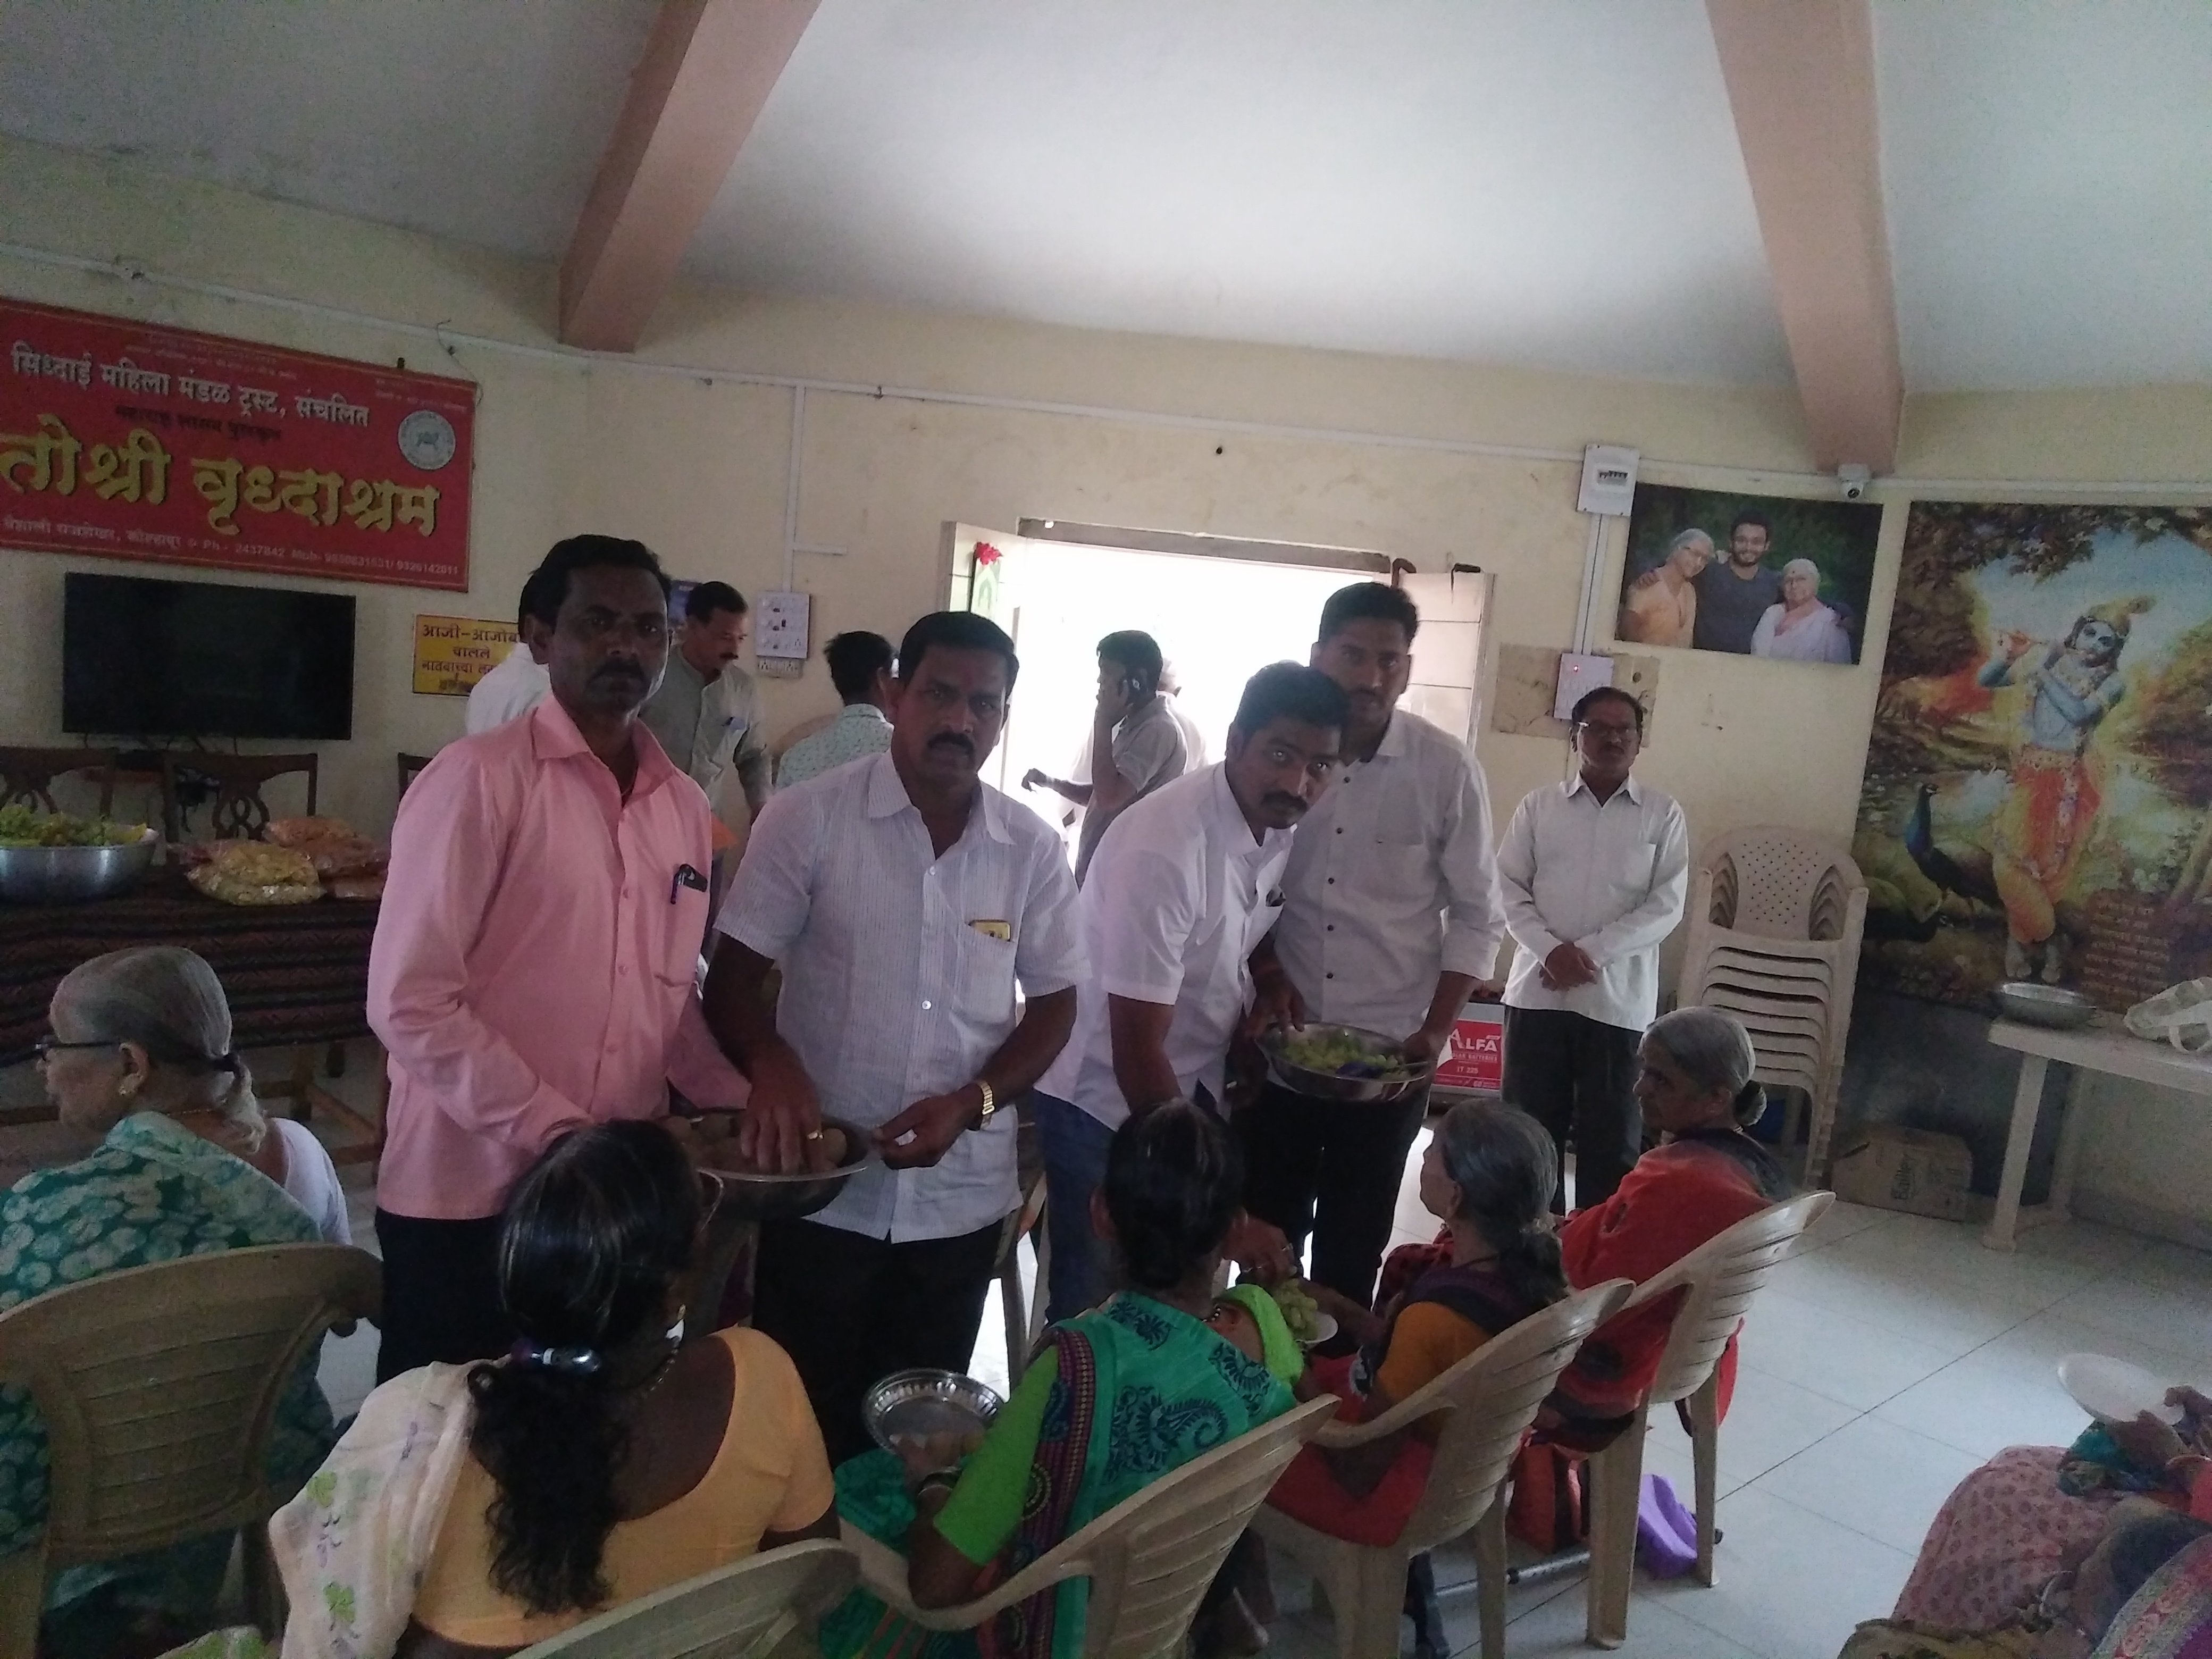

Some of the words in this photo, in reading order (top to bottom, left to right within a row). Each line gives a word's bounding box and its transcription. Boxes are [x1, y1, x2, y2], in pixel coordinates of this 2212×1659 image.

[100, 357, 171, 396] महिला
[179, 369, 231, 403] मंडळ
[0, 413, 172, 506] तोश्री
[191, 456, 441, 538] वृध्दाश्रम
[423, 624, 518, 642] आजी-आजोब
[1449, 1027, 1498, 1052] ALFA
